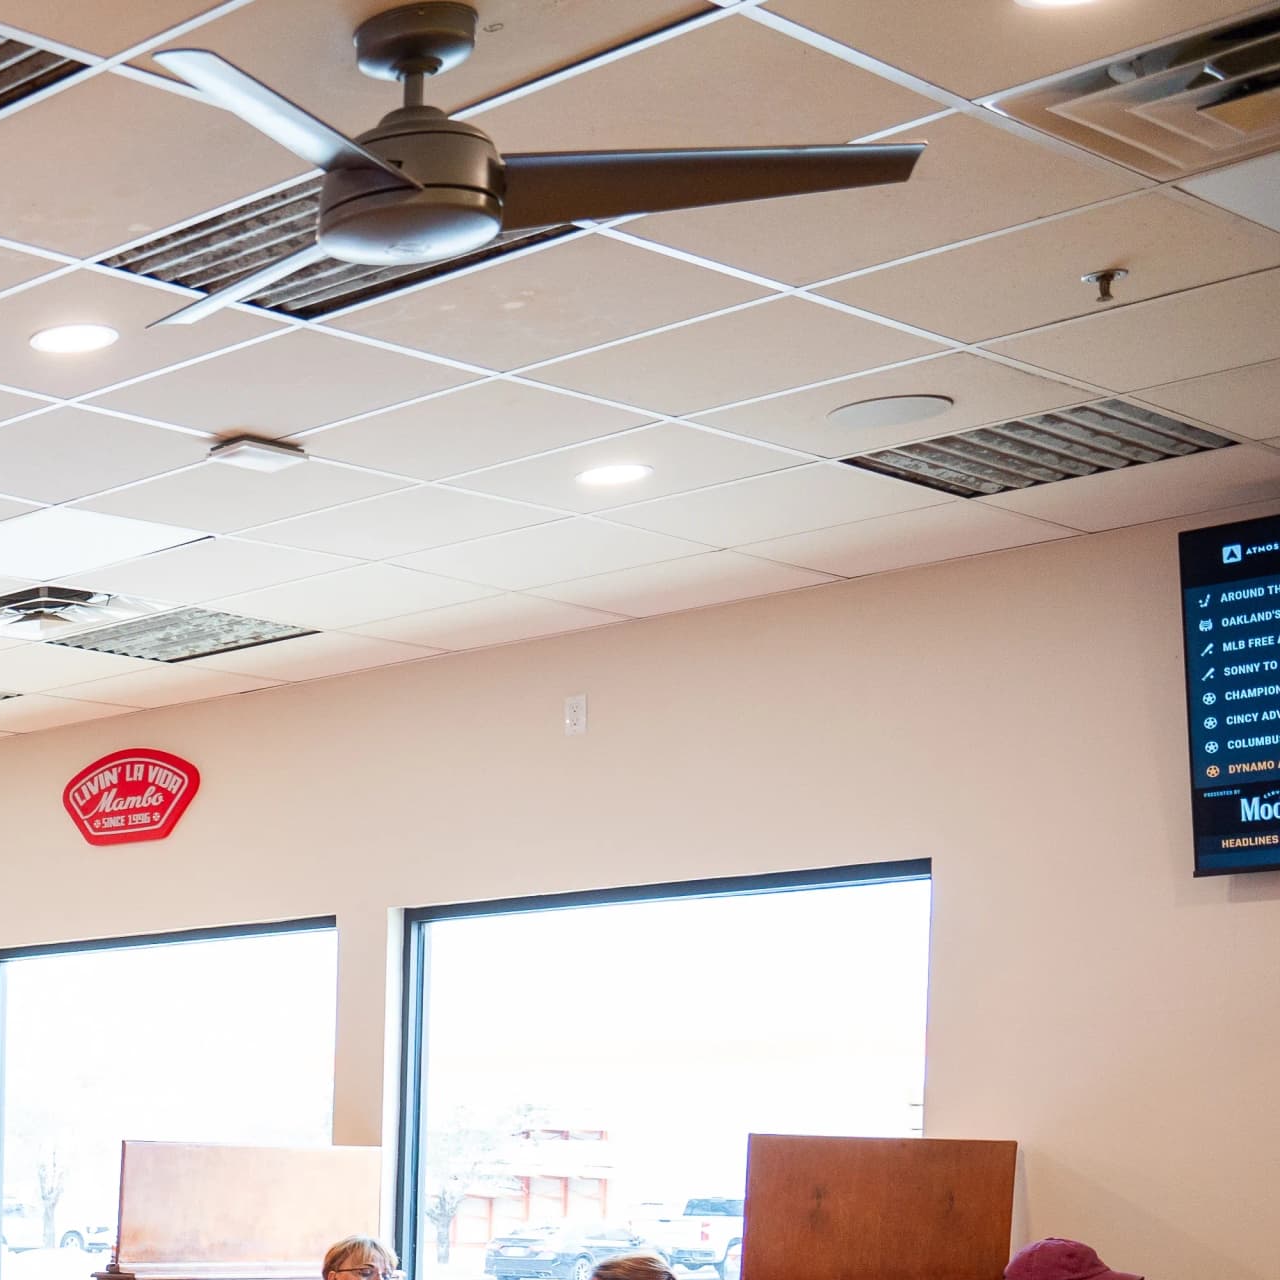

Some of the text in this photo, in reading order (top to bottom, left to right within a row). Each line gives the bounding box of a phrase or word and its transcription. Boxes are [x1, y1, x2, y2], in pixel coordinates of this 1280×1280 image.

[1220, 587, 1265, 603] AROUND
[1221, 610, 1280, 627] OAKLAND'S
[1222, 640, 1246, 652] MLB
[1248, 635, 1275, 648] FREE
[1223, 660, 1278, 676] SONNY TO
[1226, 712, 1259, 725] CINCY
[1227, 735, 1280, 749] COLUMBU
[1228, 760, 1274, 774] DYNAMO
[74, 764, 182, 806] LIVIN' LA VIDA
[97, 786, 164, 813] Mambo
[101, 816, 126, 828] SINCE
[1221, 835, 1279, 849] HEADLINES
